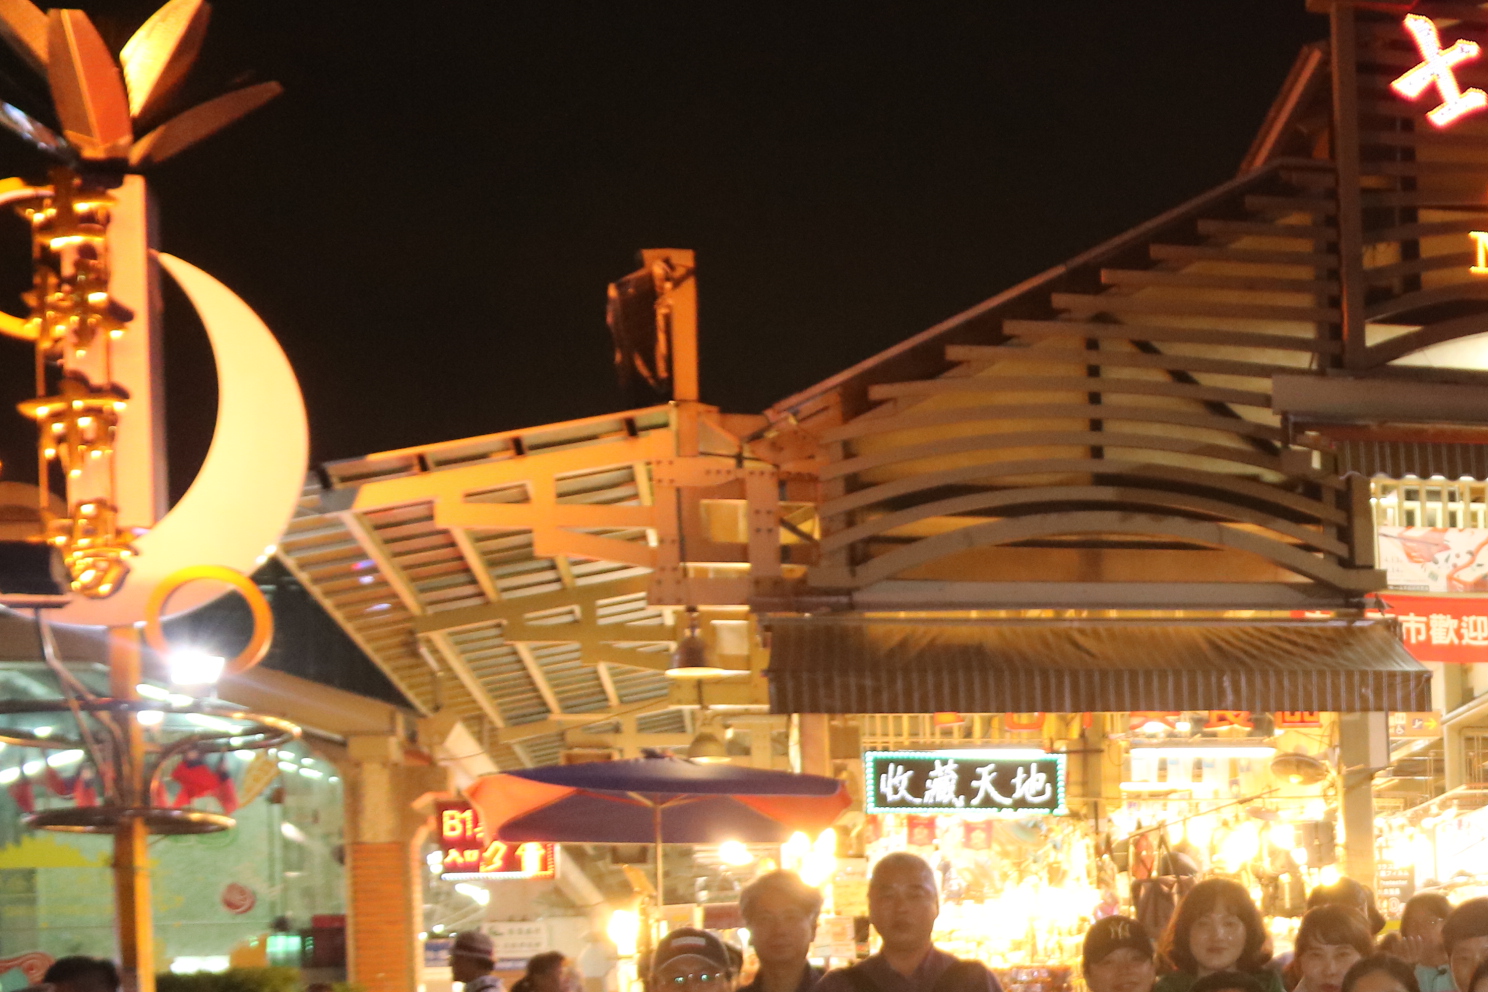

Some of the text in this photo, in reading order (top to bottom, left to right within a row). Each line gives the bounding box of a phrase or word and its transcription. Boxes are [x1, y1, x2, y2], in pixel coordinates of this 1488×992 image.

[879, 758, 1053, 808] 收藏天地
[442, 809, 485, 840] B1
